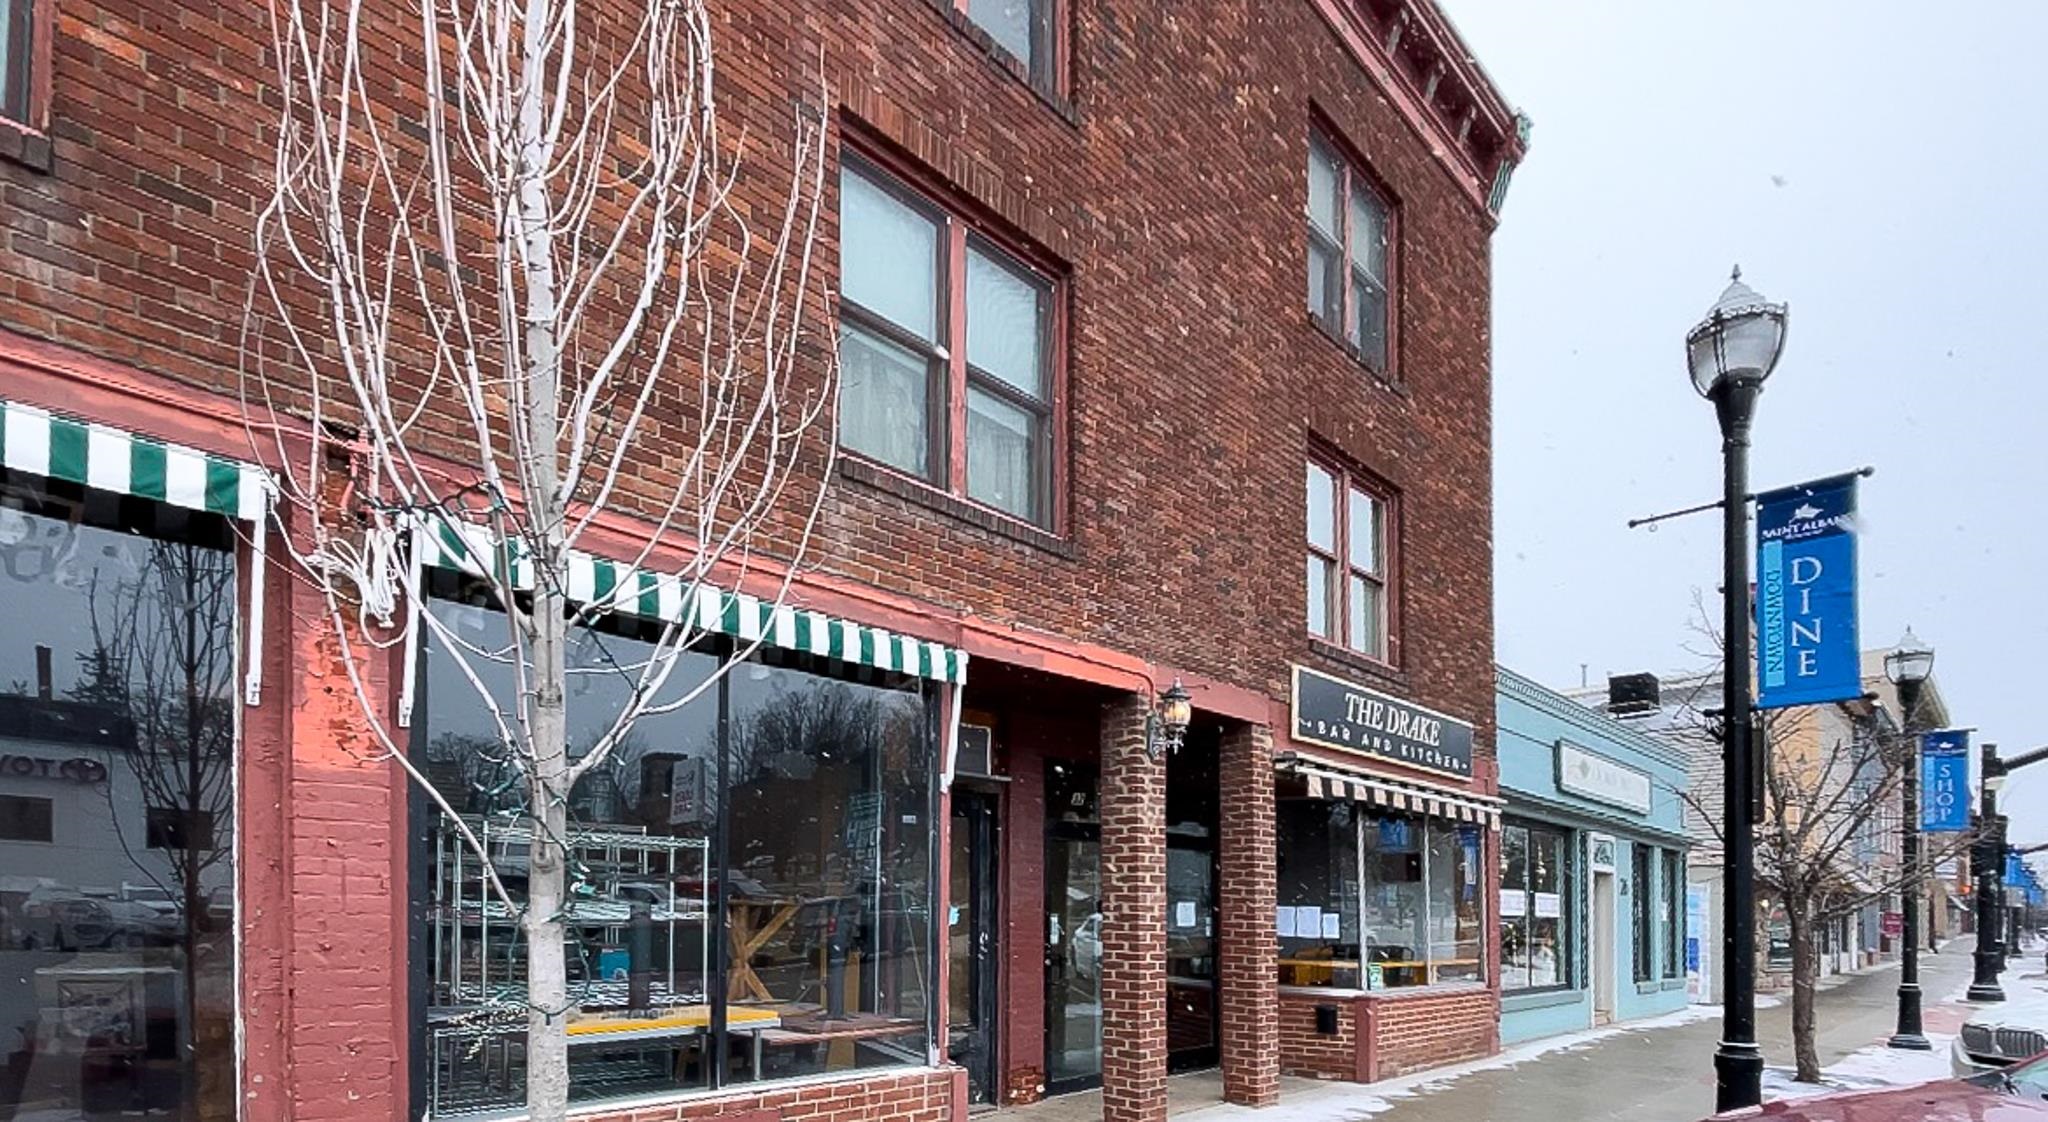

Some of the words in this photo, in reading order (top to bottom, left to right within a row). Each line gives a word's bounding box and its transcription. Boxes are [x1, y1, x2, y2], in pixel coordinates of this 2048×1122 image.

[1791, 556, 1823, 677] DINE
[1318, 720, 1350, 741] BAR
[1361, 733, 1392, 752] AND
[1401, 743, 1460, 770] KITCHEN
[1345, 692, 1384, 730] THE
[1385, 705, 1441, 746] DRAKE
[1936, 764, 1954, 822] SHOP
